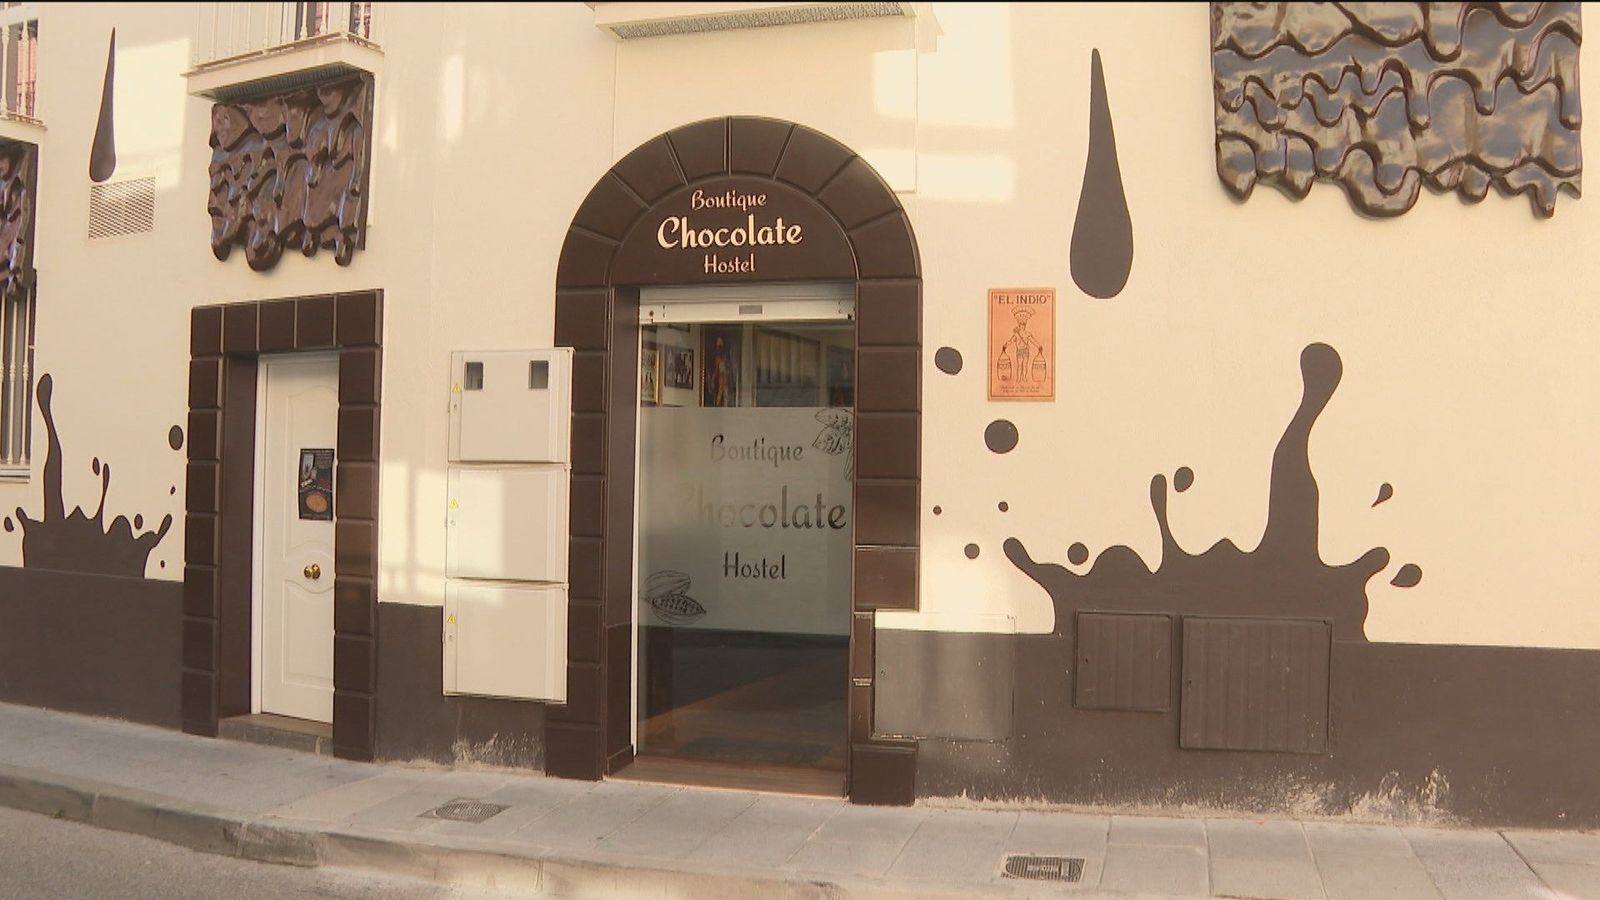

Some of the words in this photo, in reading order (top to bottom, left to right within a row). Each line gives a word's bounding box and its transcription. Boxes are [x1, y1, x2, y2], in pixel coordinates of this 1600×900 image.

[691, 189, 768, 211] Boutique
[657, 213, 803, 249] Chocolate
[704, 252, 756, 274] Hostel
[710, 434, 804, 467] Boutique
[722, 551, 787, 580] Hostel
